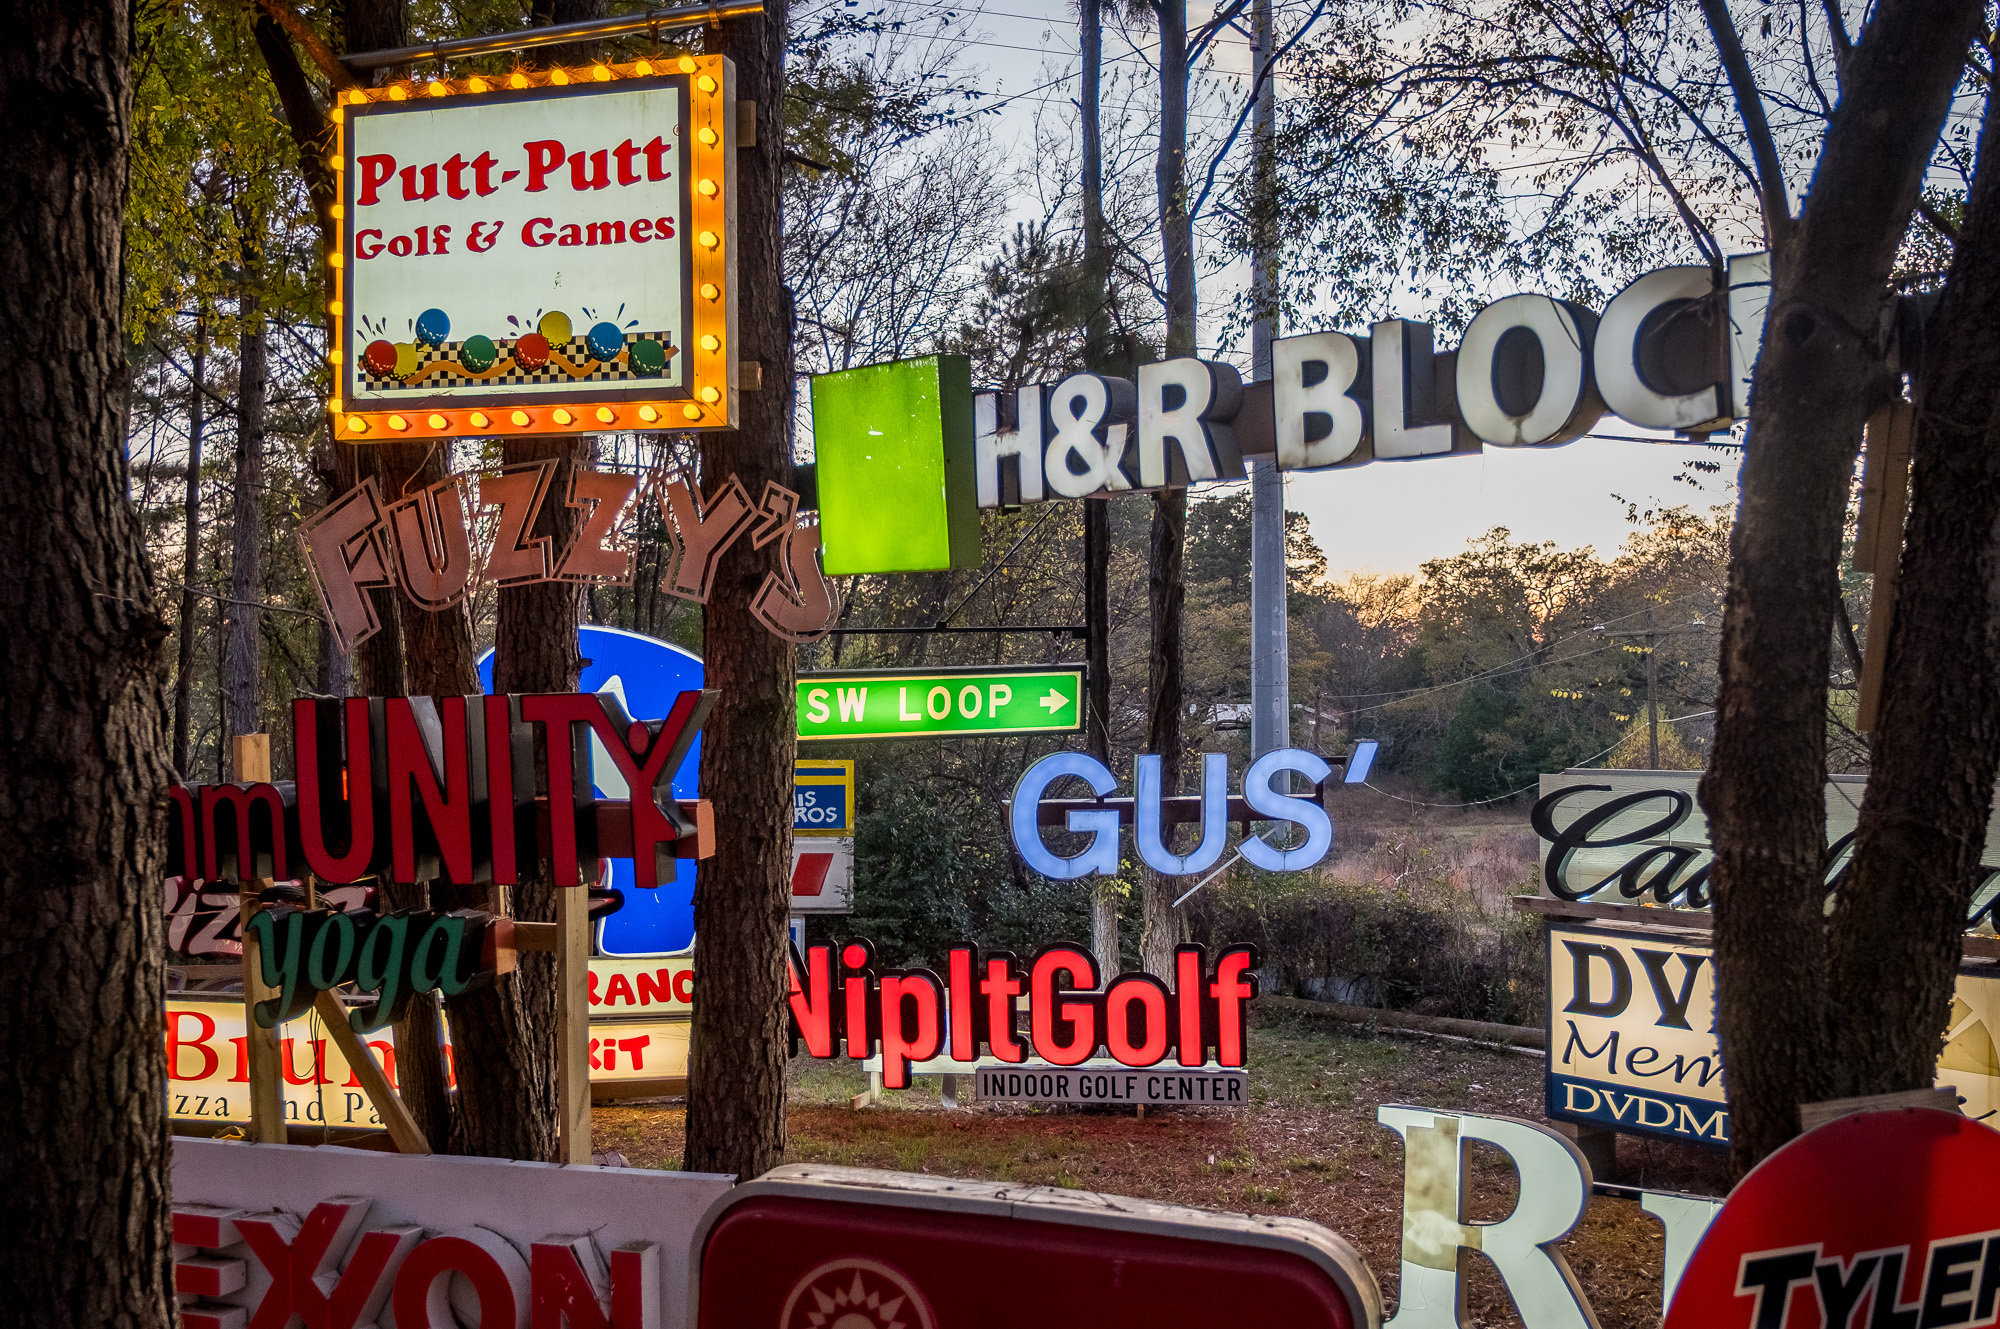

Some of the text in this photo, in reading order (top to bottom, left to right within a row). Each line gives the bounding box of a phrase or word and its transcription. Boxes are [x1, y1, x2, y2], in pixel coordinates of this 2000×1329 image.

[356, 135, 672, 206] Putt-Putt
[355, 215, 675, 260] Golf & Games
[973, 252, 1771, 509] H&R BLOC
[806, 683, 1013, 724] SW LOOP
[794, 806, 838, 824] ROS
[245, 907, 478, 1035] yoga
[1561, 938, 1716, 1033] DV
[174, 1093, 231, 1118] zza
[982, 1072, 1242, 1102] INDOOR GOLF CENTER
